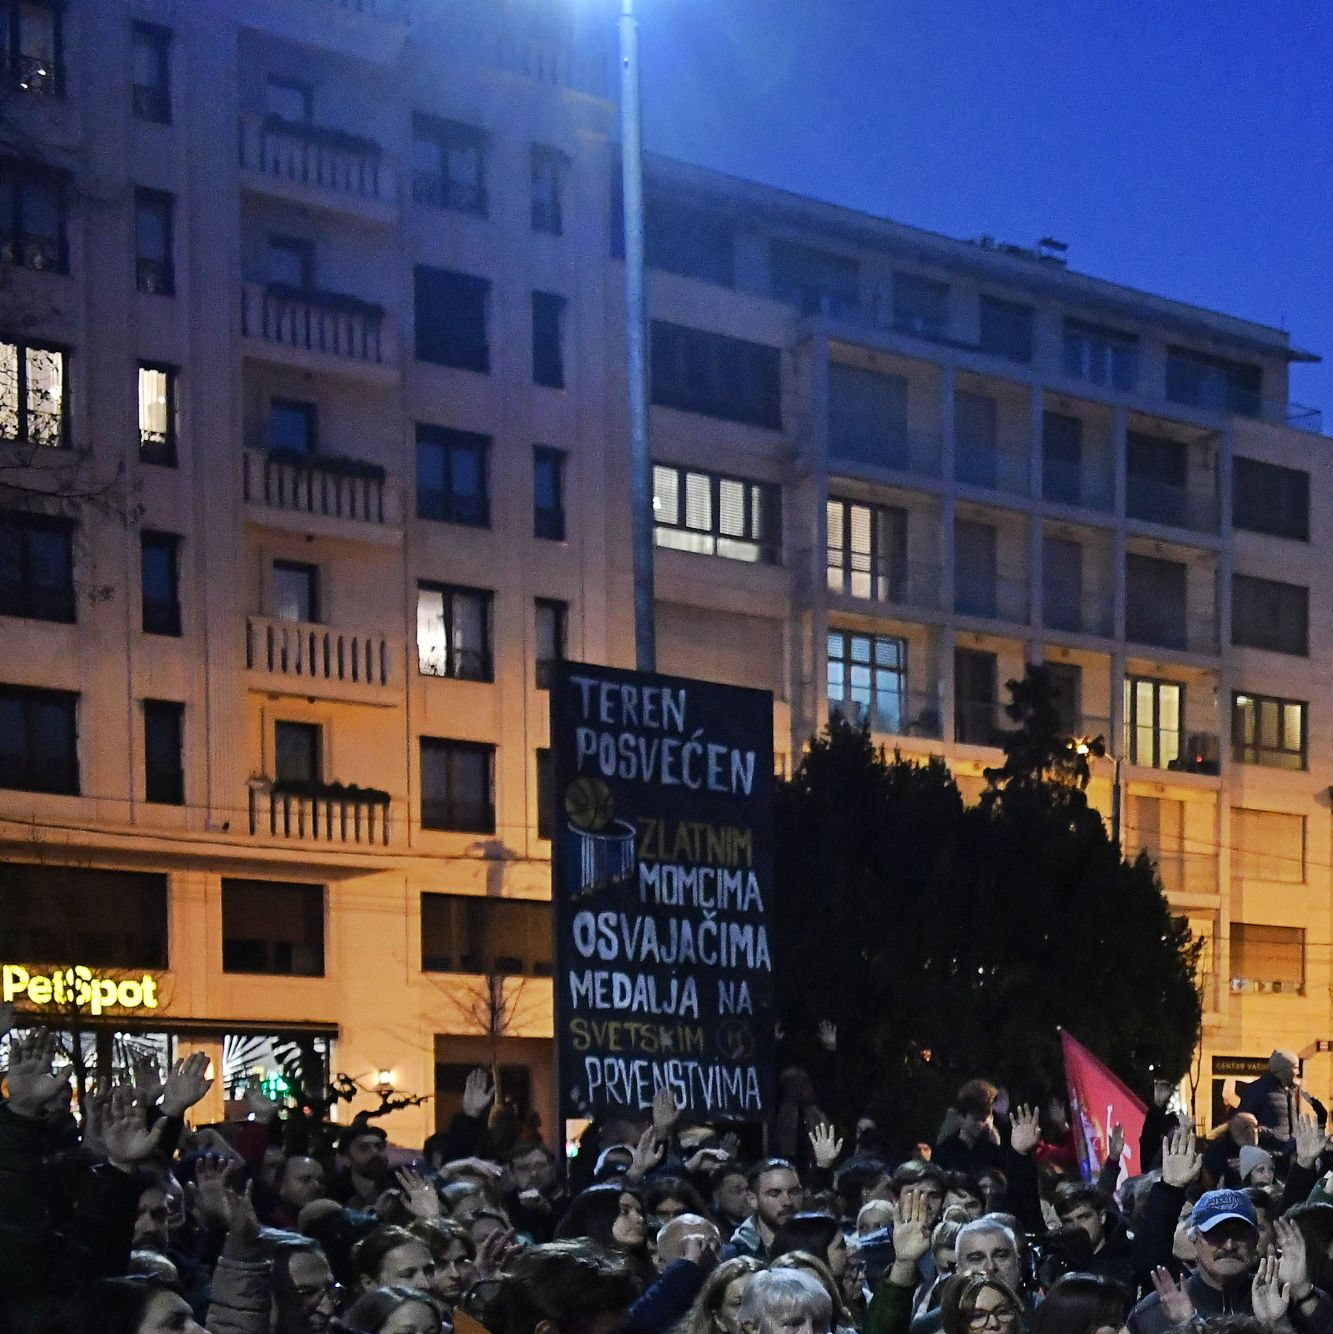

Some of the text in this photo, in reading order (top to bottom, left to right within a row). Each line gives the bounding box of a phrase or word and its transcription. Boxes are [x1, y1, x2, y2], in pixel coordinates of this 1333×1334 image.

[570, 676, 687, 733] TEREN
[575, 727, 757, 796] POSVEĆEN
[638, 816, 753, 868] ZLATNIM
[638, 862, 765, 914] MOMCIMA
[572, 909, 773, 973] OSVAJAČIMA
[2, 963, 159, 1016] PetSpot
[569, 969, 753, 1019] MEDALJA NA
[569, 1017, 703, 1054] SVETSKIM
[584, 1052, 763, 1112] PRVENSTVIMA
